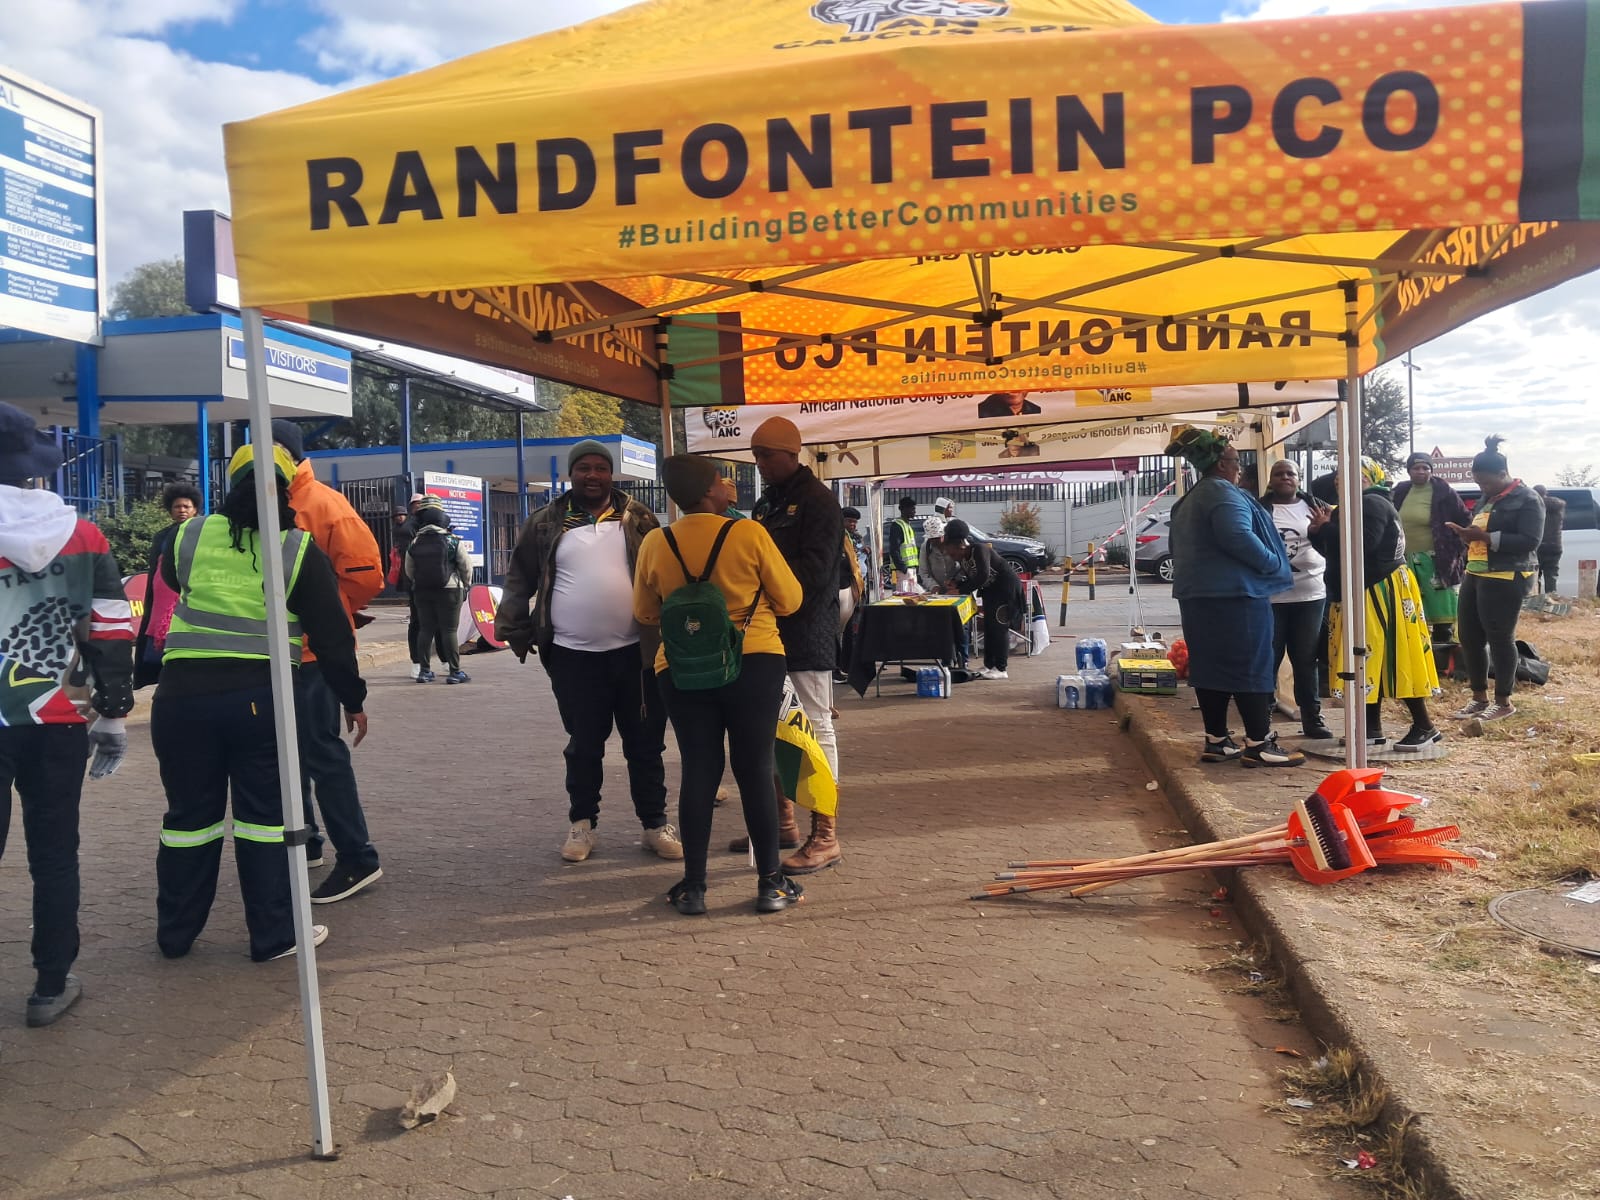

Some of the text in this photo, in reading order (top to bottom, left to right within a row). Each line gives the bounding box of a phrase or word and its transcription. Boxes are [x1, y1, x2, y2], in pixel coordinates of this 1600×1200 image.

[881, 17, 980, 30] AN
[773, 27, 975, 50] CAUCUS
[306, 69, 1441, 231] RANDFONTEIN PCO
[617, 190, 1138, 249] #BuildingBetterCommunities
[269, 347, 317, 374] VISITORS
[1109, 391, 1133, 402] ANC
[800, 401, 846, 416] African
[850, 396, 905, 411] National
[718, 426, 742, 438] ANC
[1432, 460, 1474, 469] onalesed
[1431, 472, 1463, 480] ursing
[448, 490, 467, 499] NOTICE
[788, 711, 816, 741] AN
